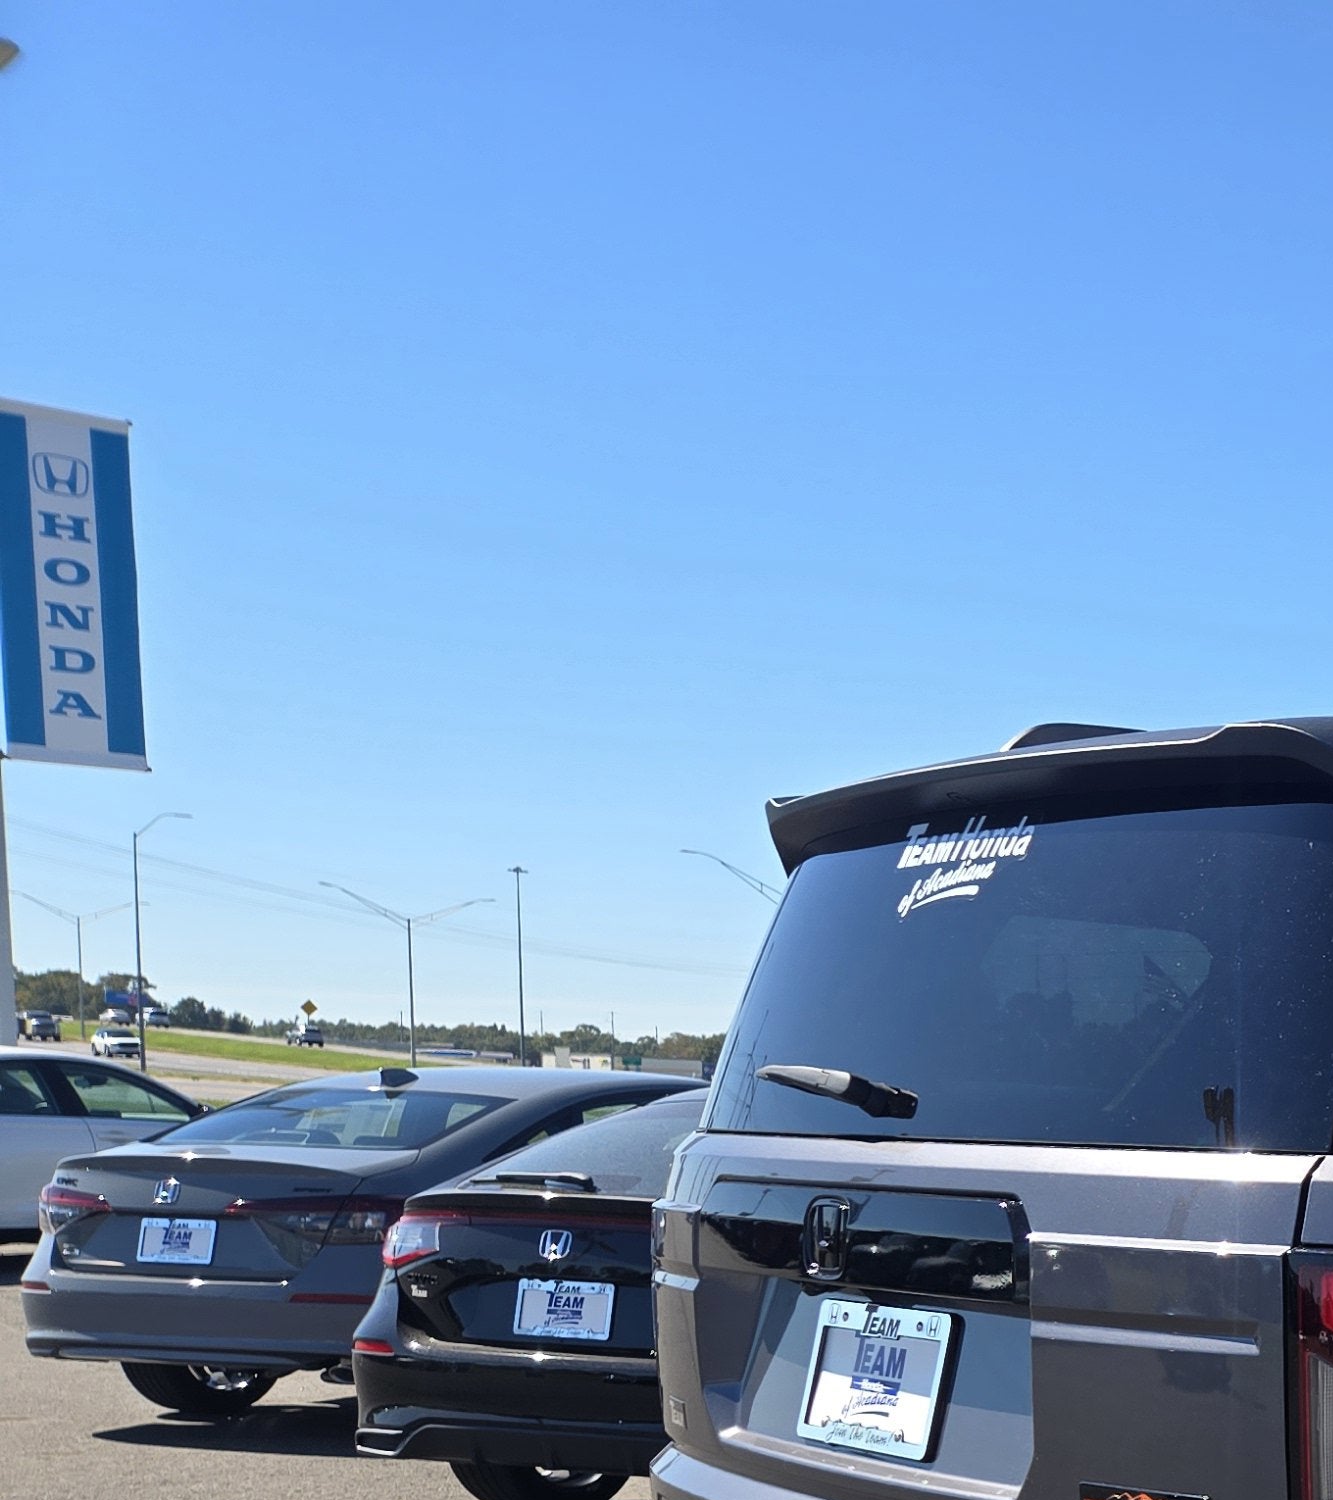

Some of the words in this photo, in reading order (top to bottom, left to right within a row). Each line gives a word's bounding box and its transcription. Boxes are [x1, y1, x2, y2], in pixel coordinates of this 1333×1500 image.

[37, 512, 102, 720] HONDA
[950, 815, 1036, 861] Honda
[897, 879, 922, 918] of
[917, 860, 997, 900] Acadiana
[546, 1291, 585, 1309] TEAM
[553, 1279, 581, 1294] TEAM
[862, 1303, 902, 1338] TEAM
[853, 1332, 907, 1380] TEAM
